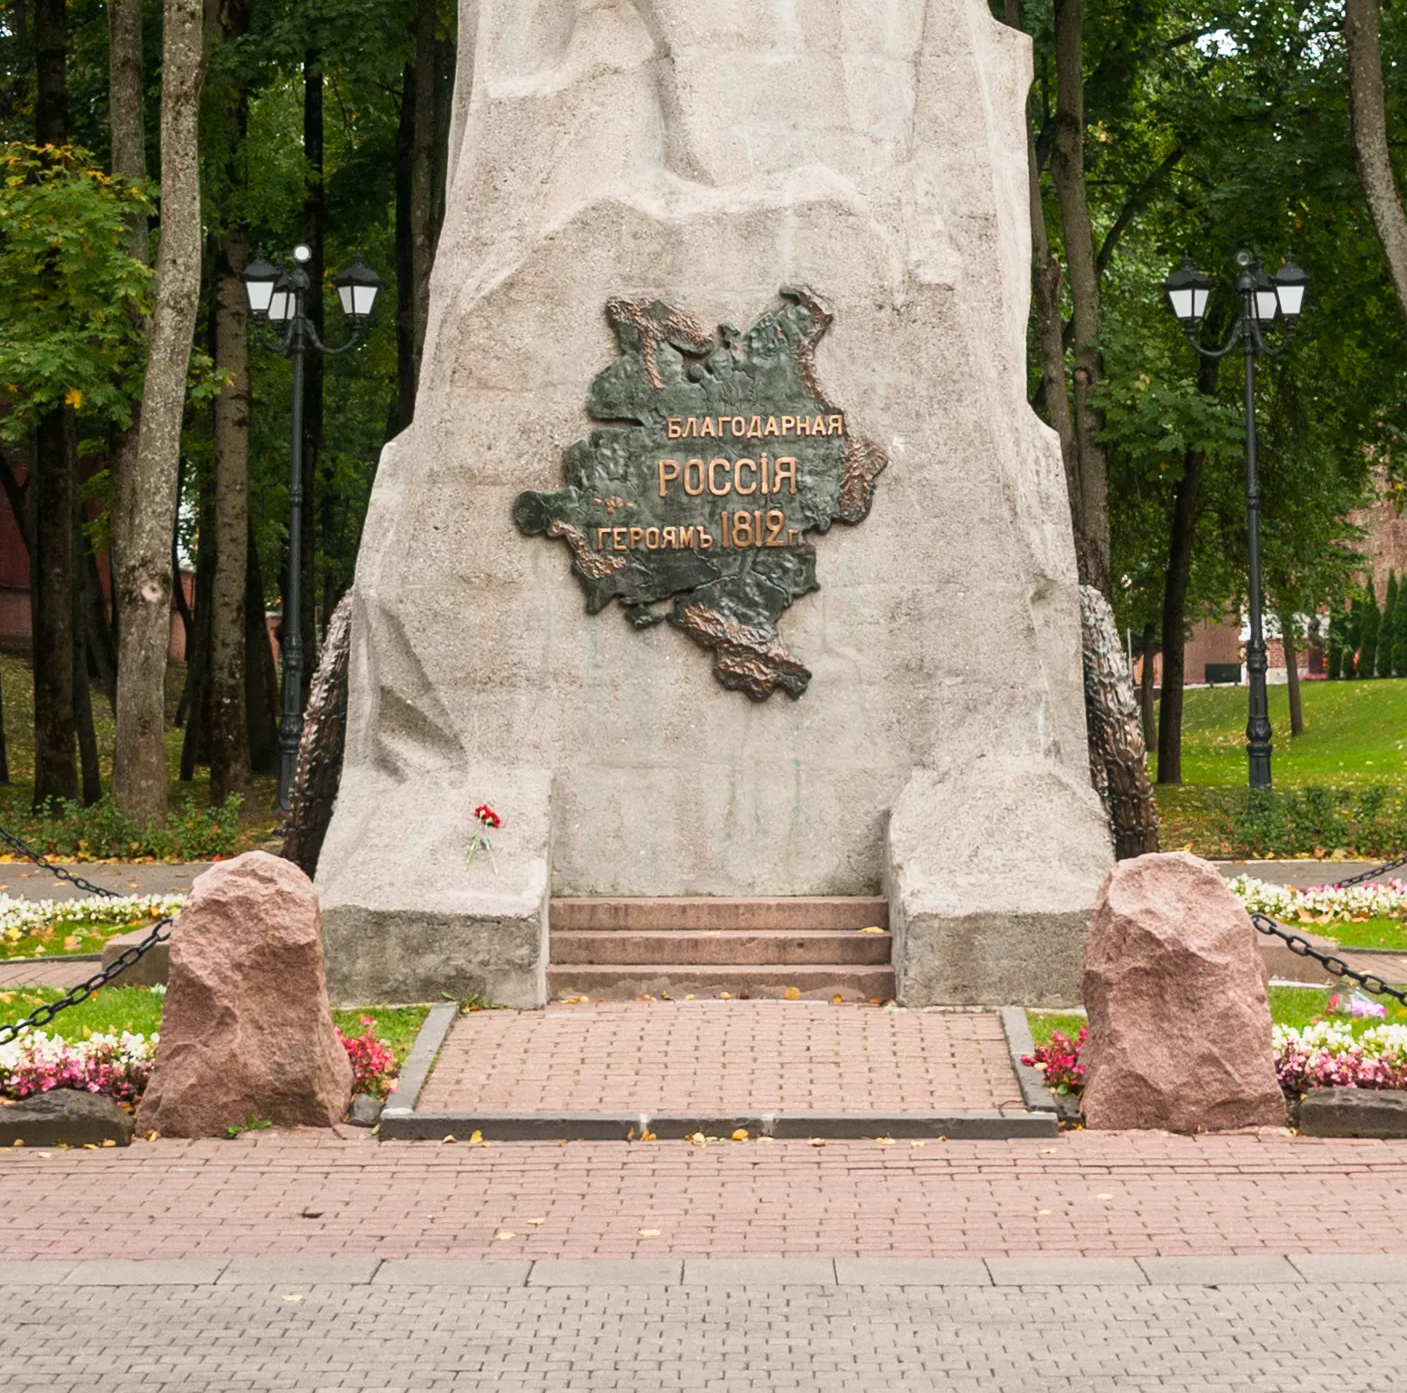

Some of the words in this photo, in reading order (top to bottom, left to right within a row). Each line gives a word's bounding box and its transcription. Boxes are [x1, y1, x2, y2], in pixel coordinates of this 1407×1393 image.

[667, 414, 843, 440] БЛАГОДАРНАЯ
[658, 452, 797, 498] РОССІЯ
[596, 525, 713, 551] ГЕРОЯМЪ
